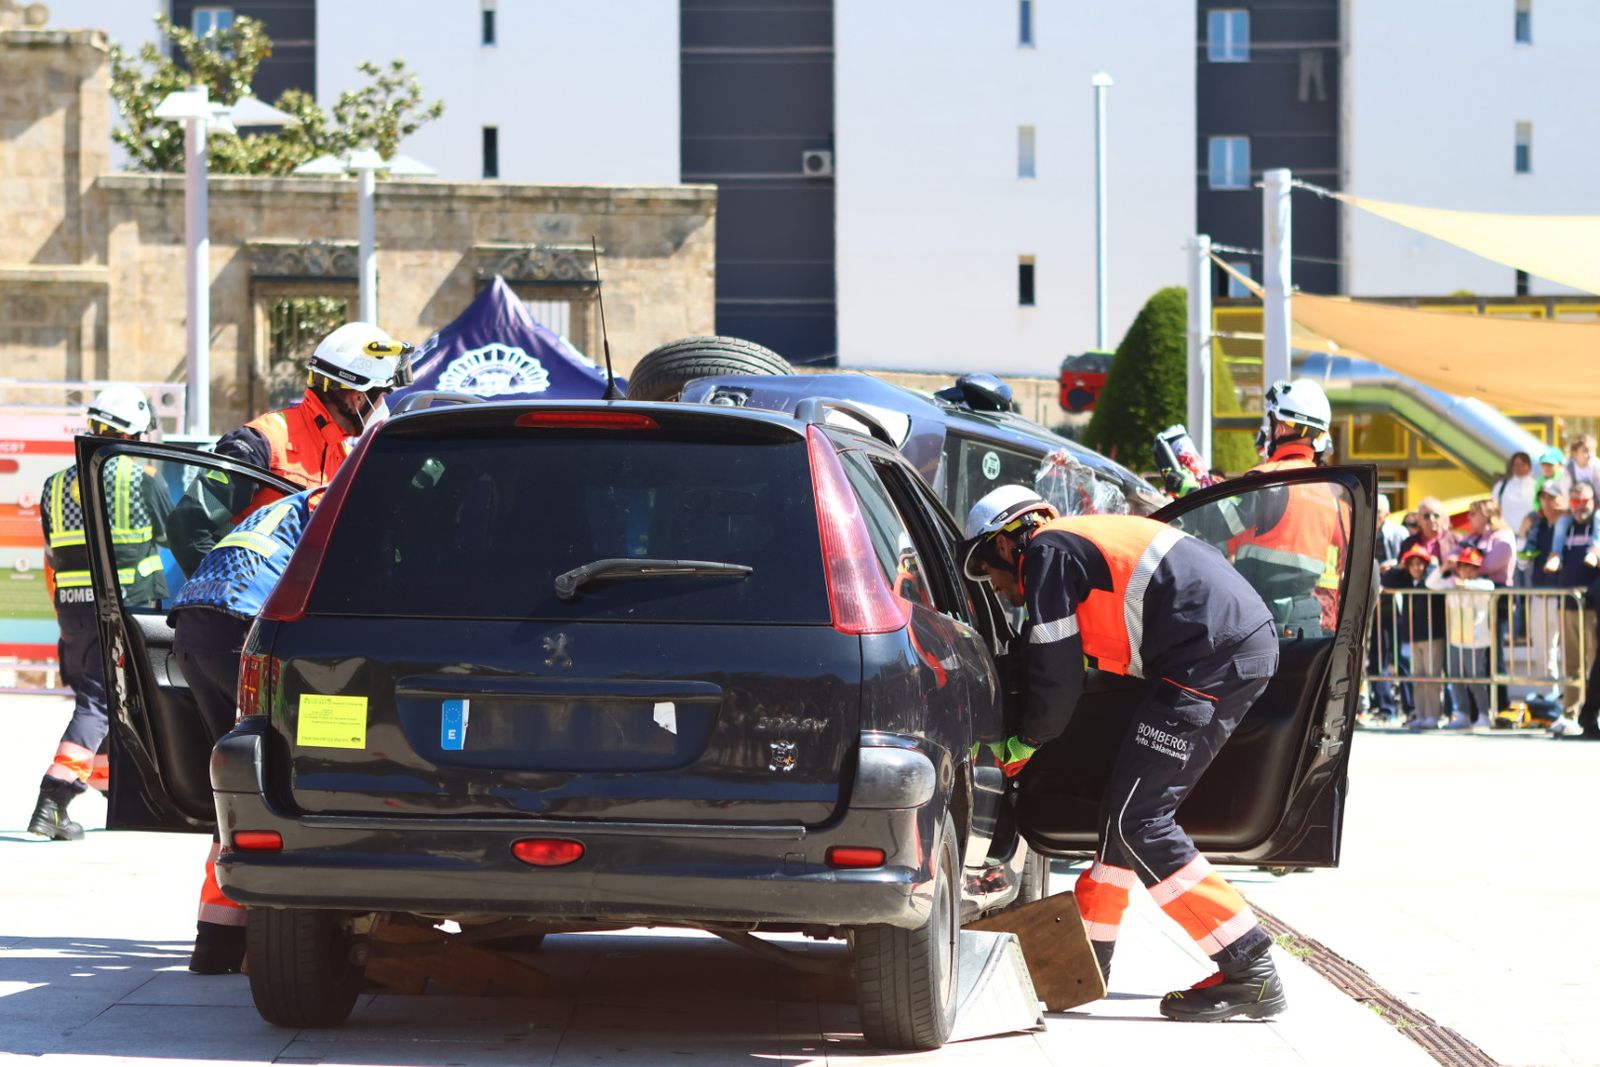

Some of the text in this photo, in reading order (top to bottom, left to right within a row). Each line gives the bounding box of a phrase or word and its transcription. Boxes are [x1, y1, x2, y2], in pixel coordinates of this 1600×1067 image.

[447, 729, 456, 740] E
[1137, 722, 1188, 752] BOMBEROS
[1150, 740, 1187, 761] Salamanca
